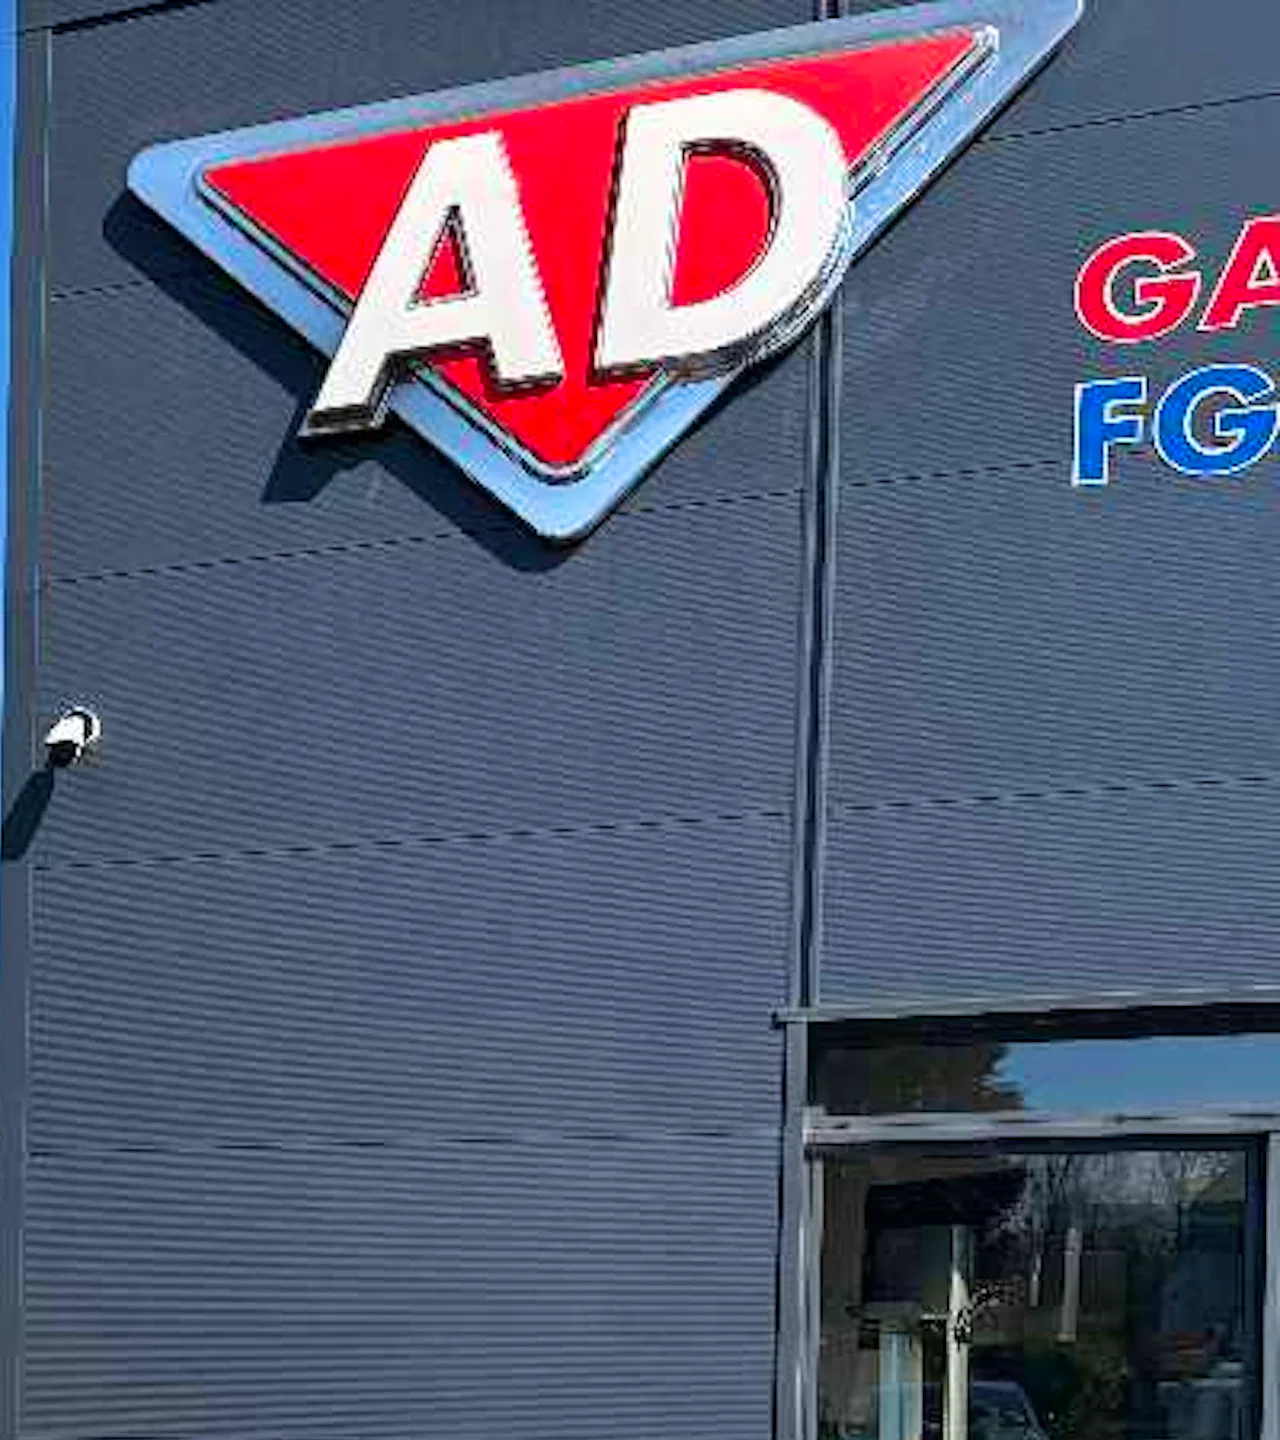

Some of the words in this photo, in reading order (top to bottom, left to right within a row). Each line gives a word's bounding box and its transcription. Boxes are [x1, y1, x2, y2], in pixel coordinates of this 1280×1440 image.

[302, 88, 852, 434] AD
[1074, 214, 1280, 343] GA
[1072, 364, 1280, 486] FG
